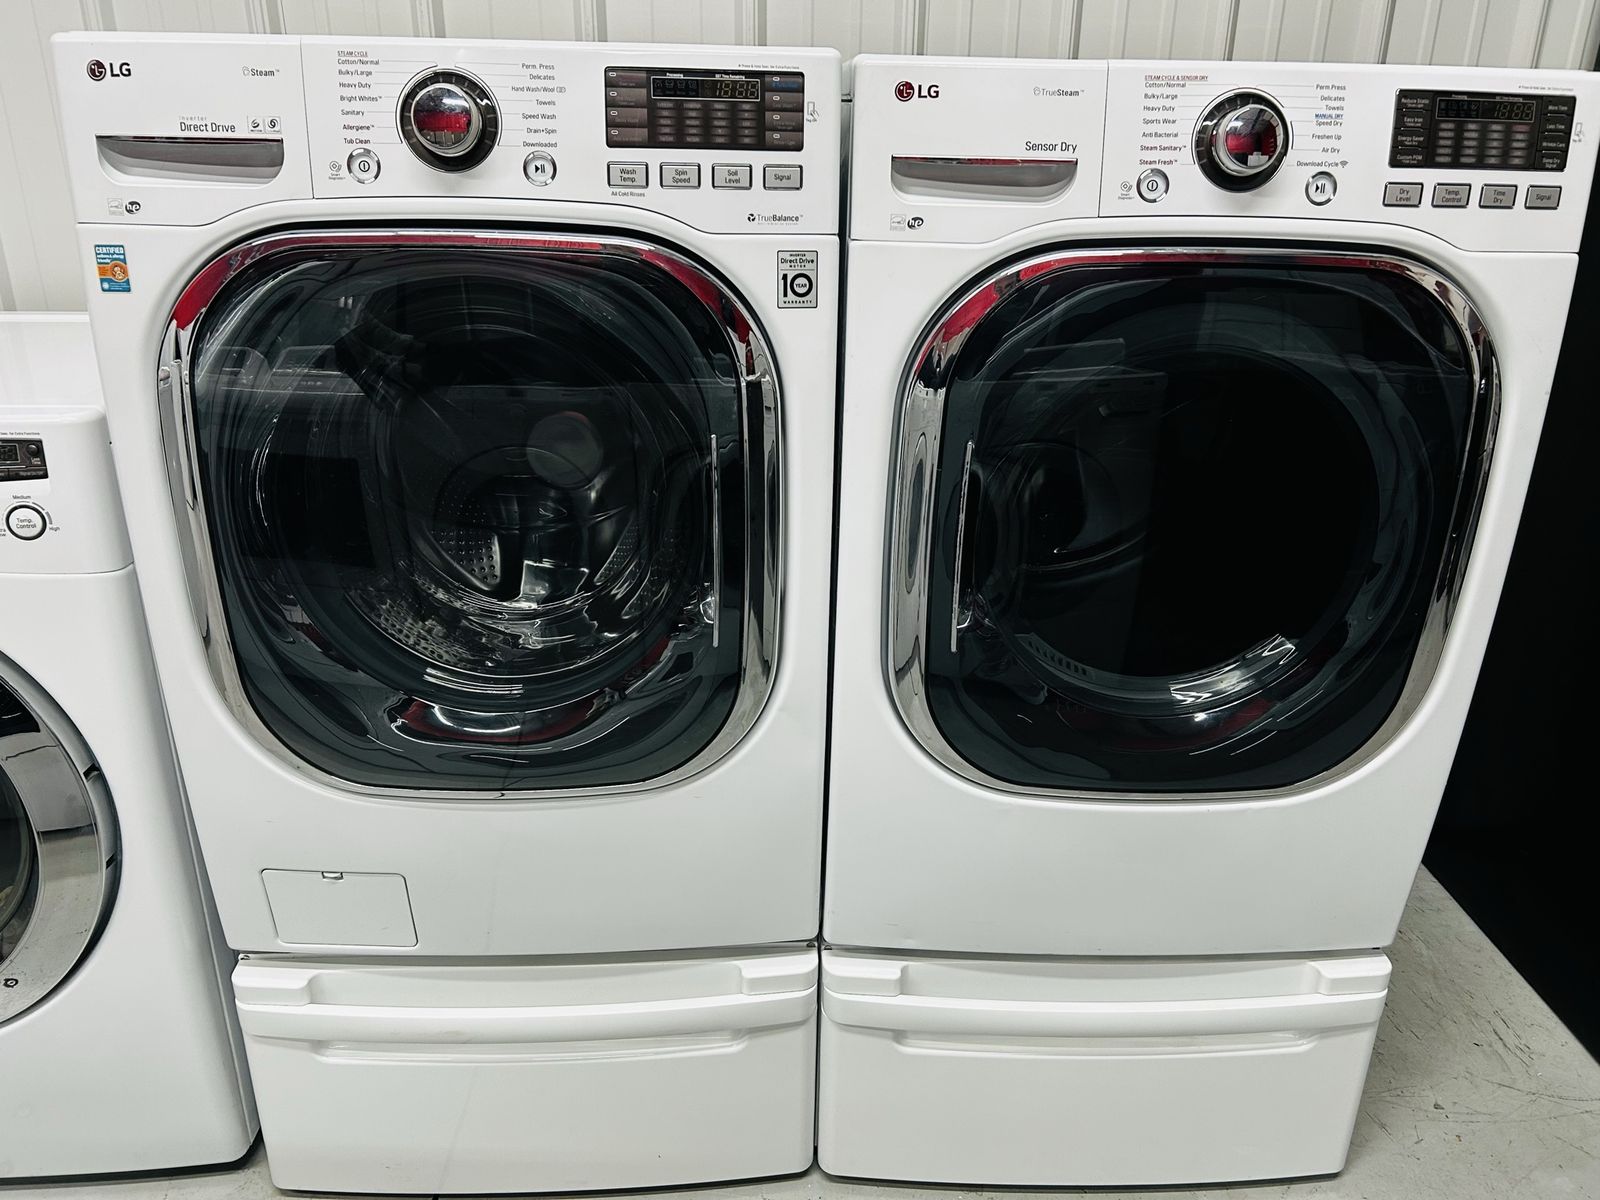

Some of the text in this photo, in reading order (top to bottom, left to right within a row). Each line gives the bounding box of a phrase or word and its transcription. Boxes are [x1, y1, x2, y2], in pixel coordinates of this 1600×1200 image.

[338, 58, 380, 66] Cotton/Normal
[109, 62, 131, 78] LG
[918, 84, 940, 99] LG
[340, 95, 355, 103] Bright
[341, 109, 365, 117] Sanitary
[180, 122, 236, 132] Direct Drive
[1025, 141, 1078, 154] Sensor Dry
[1296, 160, 1339, 168] Download Cycle
[619, 168, 637, 176] Wash
[675, 169, 688, 177] Spin
[672, 176, 691, 185] Speed
[774, 173, 792, 182] Signal
[781, 273, 814, 298] 10
